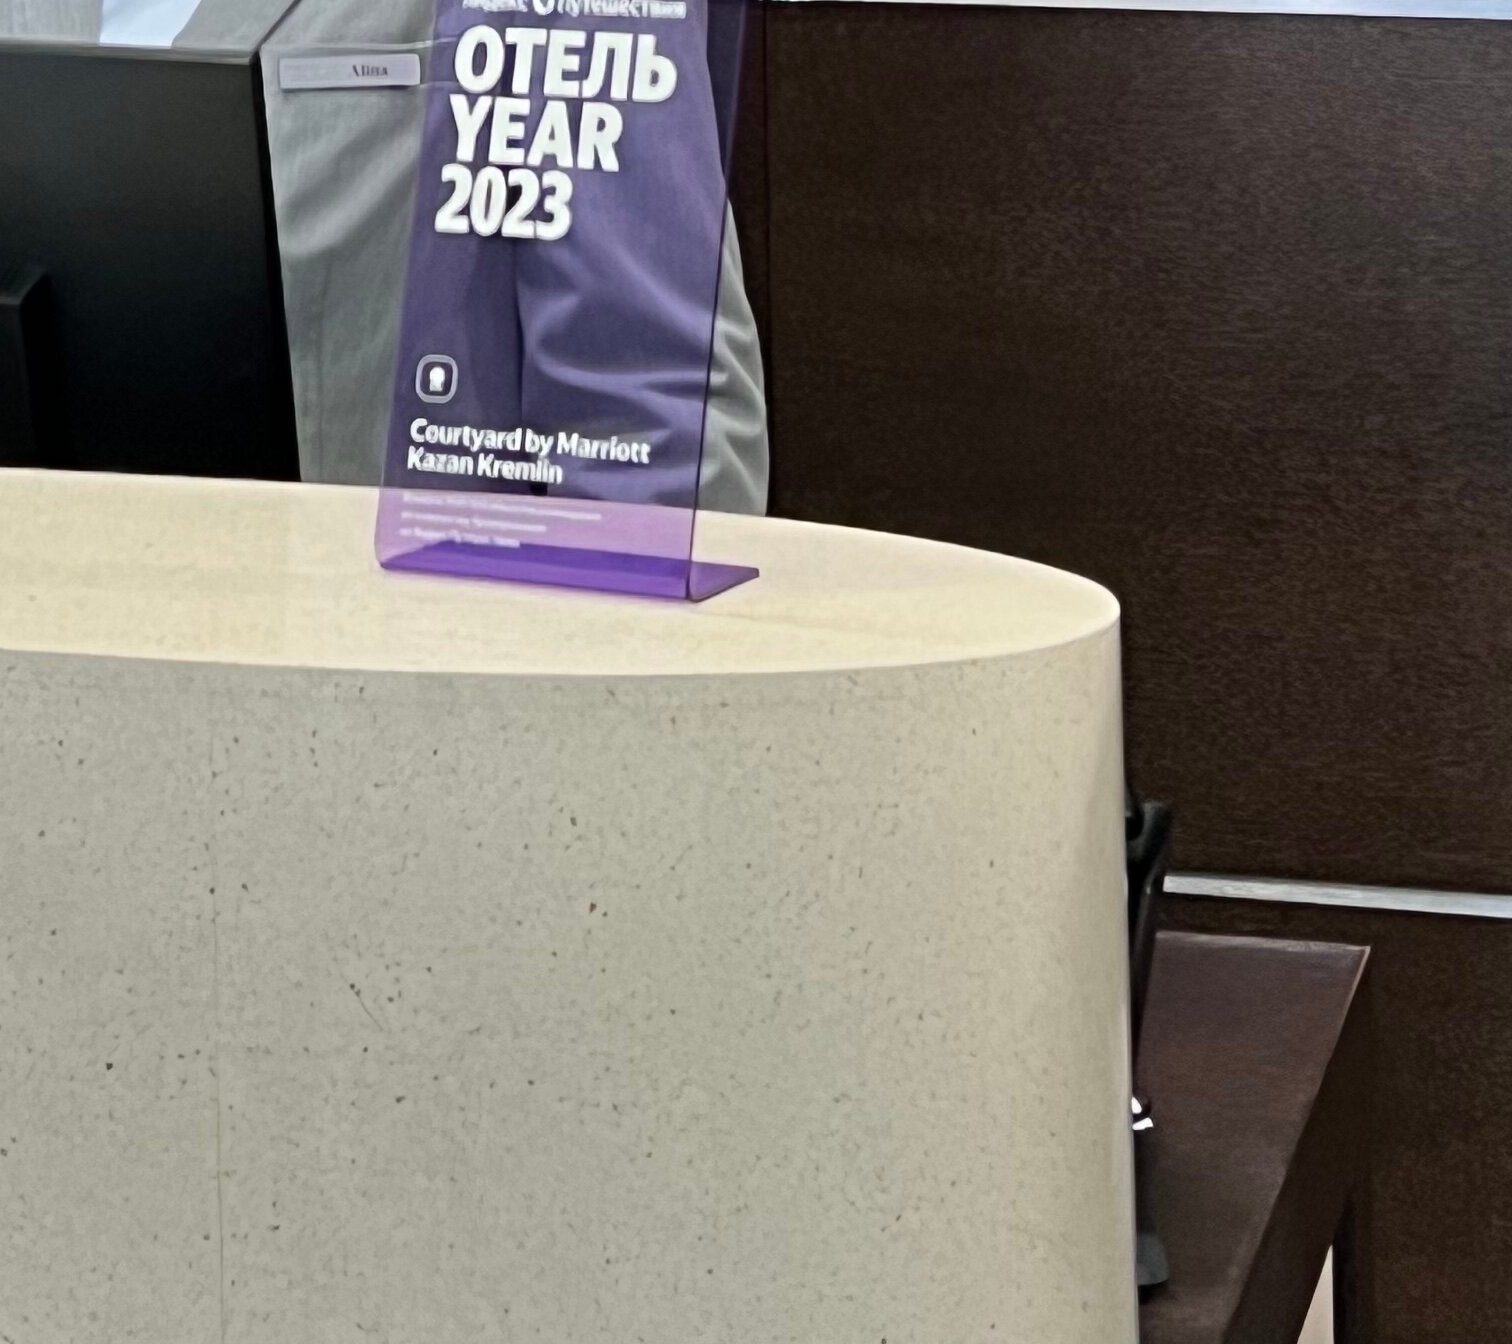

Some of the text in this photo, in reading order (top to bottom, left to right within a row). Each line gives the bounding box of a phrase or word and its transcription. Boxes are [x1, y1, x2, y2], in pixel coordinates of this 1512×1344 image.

[454, 24, 678, 103] ОТЕЛЬ
[449, 93, 624, 173] YEAR
[434, 162, 574, 241] 2023
[407, 445, 564, 484] Kazan Kremlin
[410, 417, 652, 464] Courtyard by Marriott
